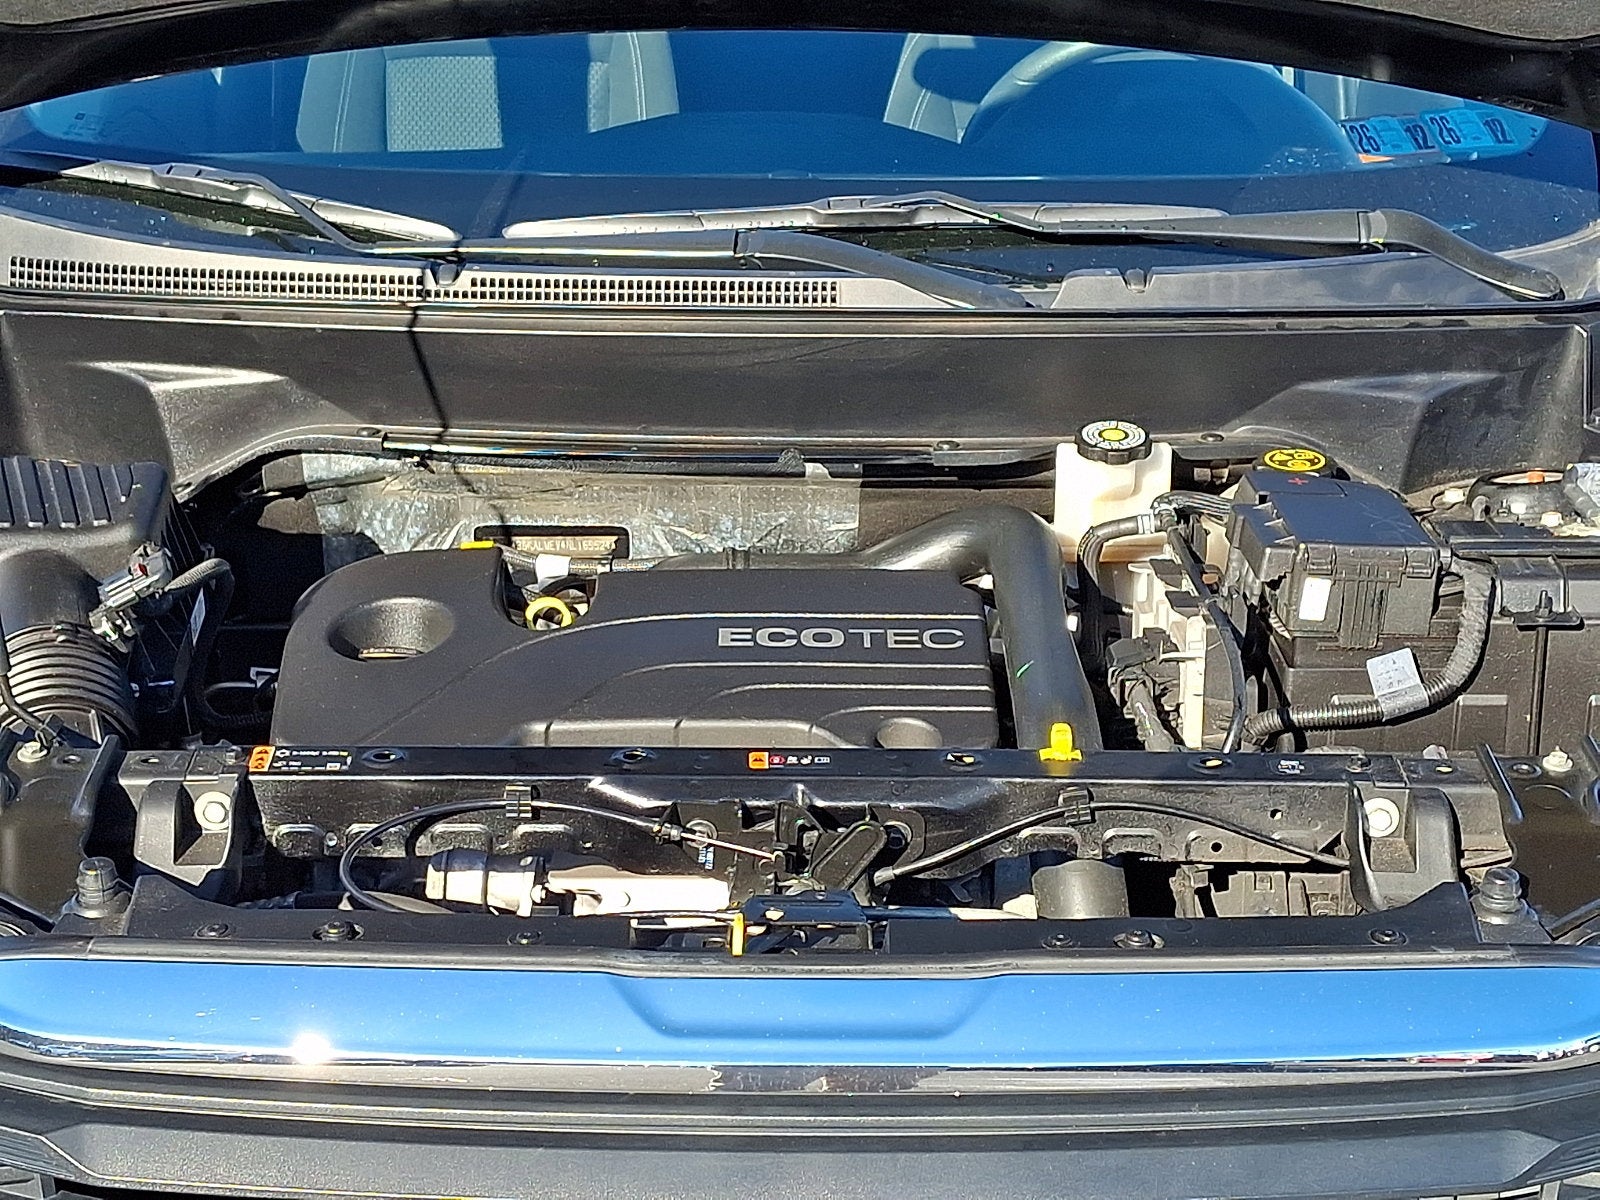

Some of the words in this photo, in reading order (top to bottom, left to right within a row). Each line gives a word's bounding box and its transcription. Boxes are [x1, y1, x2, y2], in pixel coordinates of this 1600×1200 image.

[1350, 123, 1380, 153] 26
[1404, 124, 1436, 150] 12
[1430, 116, 1462, 145] 26
[1483, 118, 1514, 144] 12
[717, 627, 965, 649] ECOTEC
